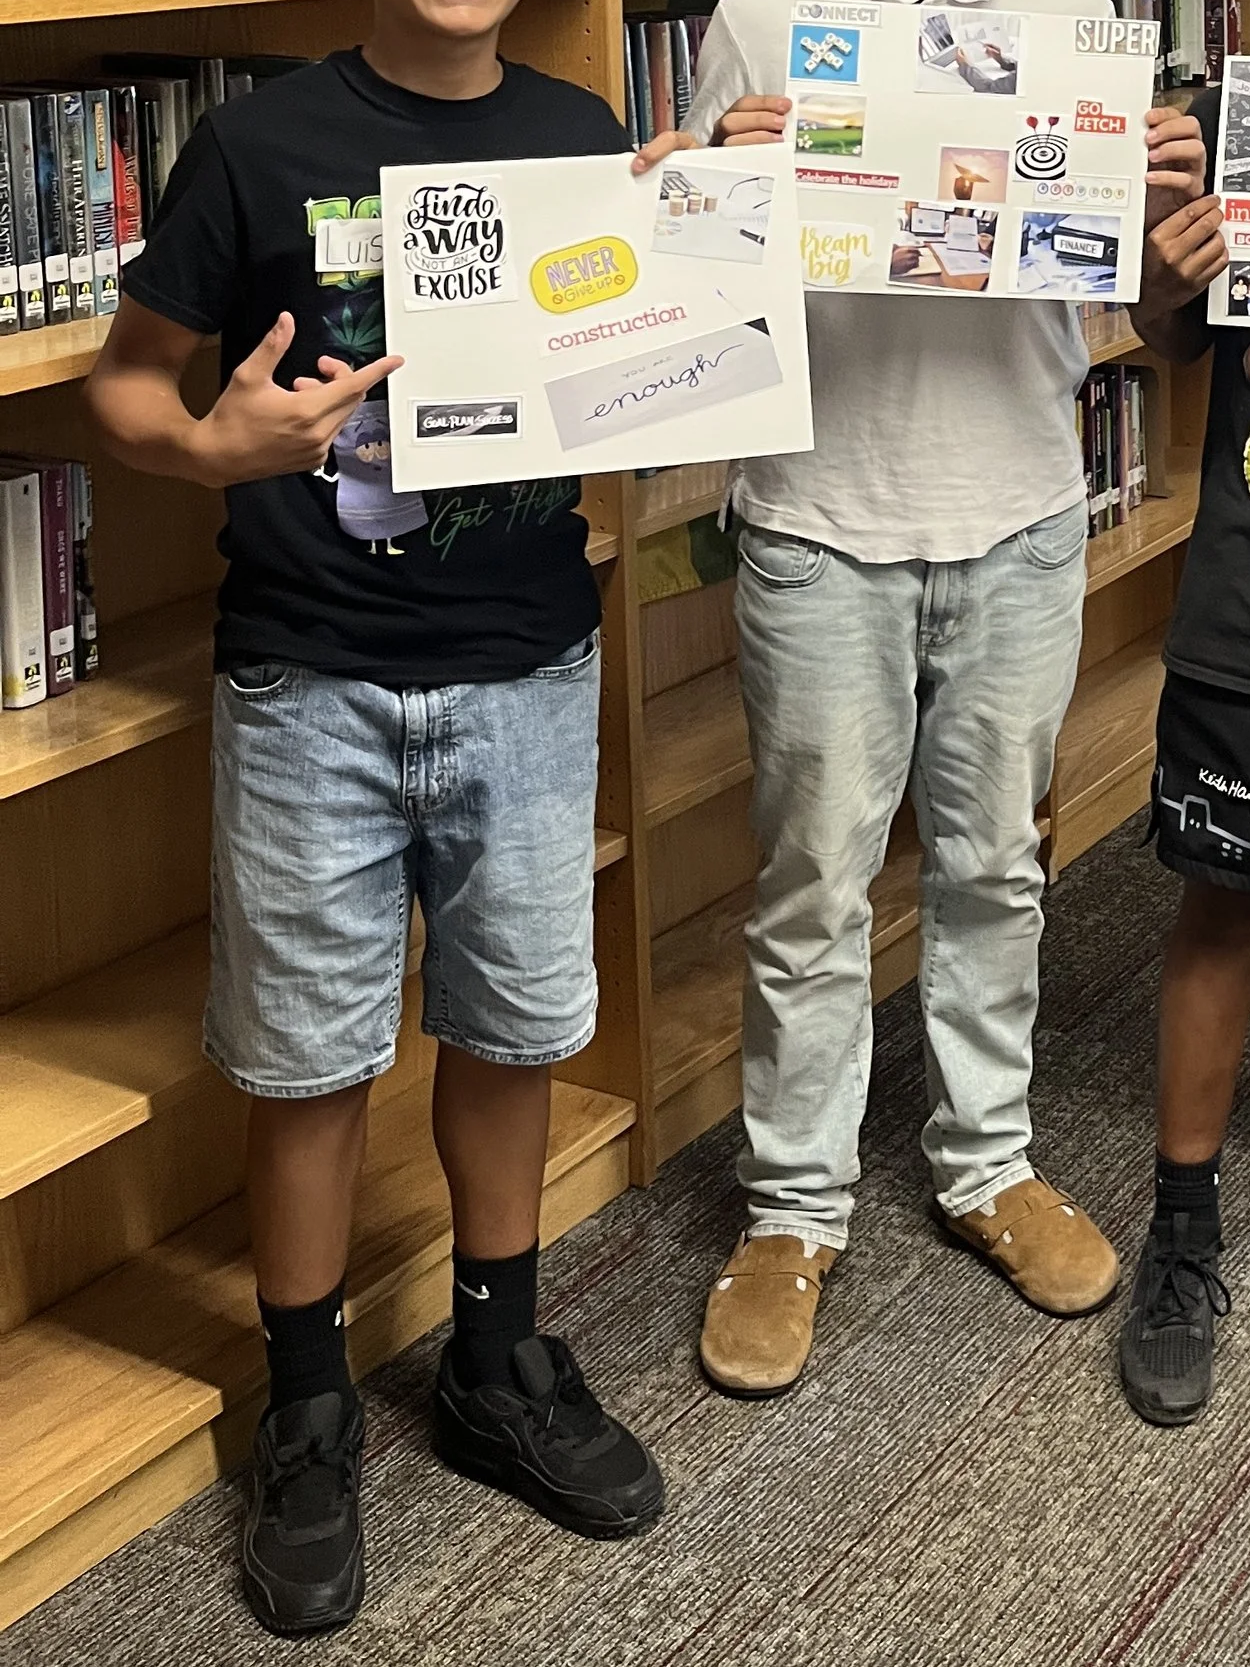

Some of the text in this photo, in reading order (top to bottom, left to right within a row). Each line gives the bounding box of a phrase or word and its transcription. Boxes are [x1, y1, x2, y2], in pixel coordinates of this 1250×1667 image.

[798, 3, 878, 22] CONNECT
[1076, 19, 1156, 56] SUPER
[1075, 116, 1124, 132] FETCH.
[1077, 101, 1101, 115] GO
[71, 160, 82, 192] HEIR
[796, 171, 899, 189] Celebrate the holidays
[406, 183, 494, 227] Find
[404, 218, 503, 263] a WAY
[1059, 238, 1098, 255] FINANCE
[421, 254, 470, 270] NOT AN
[545, 246, 619, 292] NEVER
[808, 250, 851, 285] big
[414, 266, 502, 302] EXCUSE
[564, 276, 613, 303] Give up
[547, 305, 688, 352] construction
[585, 343, 745, 422] enough
[430, 480, 578, 562] Get High
[1198, 767, 1229, 792] Keith
